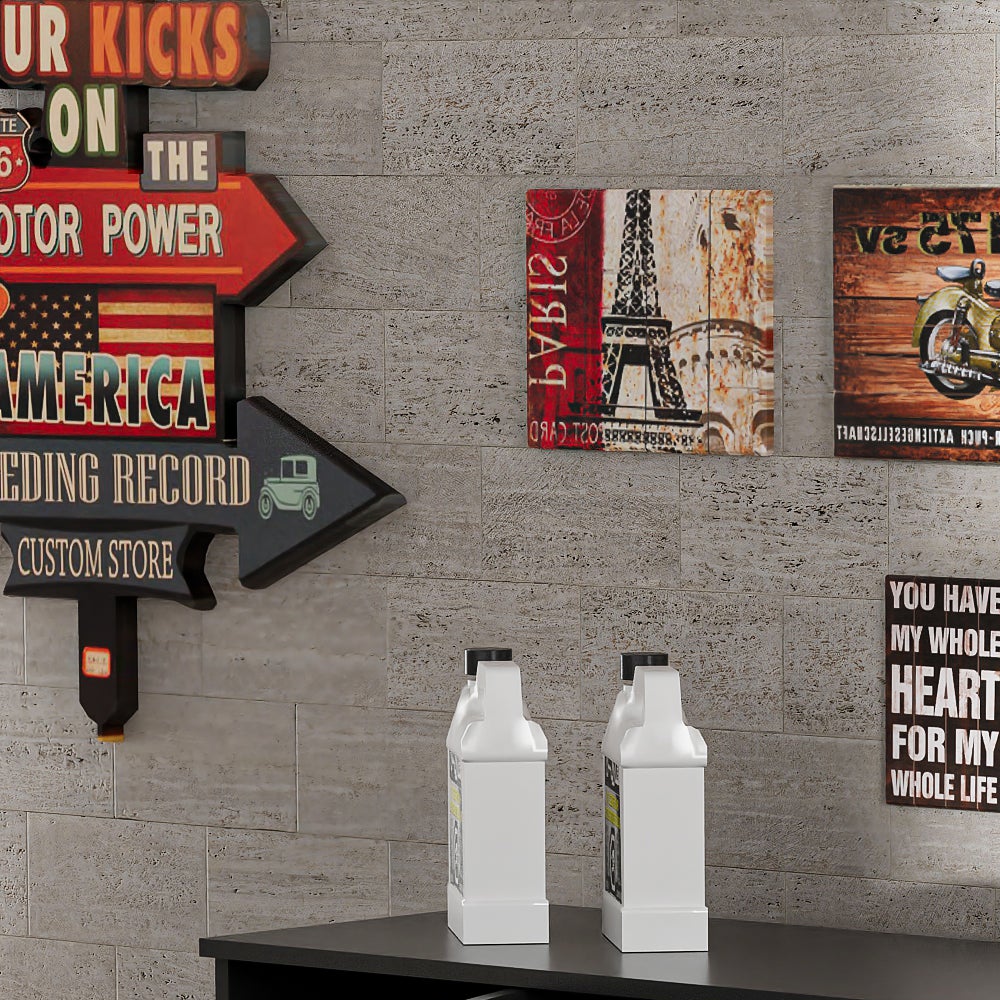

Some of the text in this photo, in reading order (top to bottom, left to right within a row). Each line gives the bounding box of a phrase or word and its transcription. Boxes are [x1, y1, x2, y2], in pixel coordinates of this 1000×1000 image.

[91, 3, 239, 77] KICKS
[49, 86, 117, 155] ON
[147, 140, 209, 182] THE
[102, 203, 224, 257] POWER
[112, 453, 251, 507] RECORD
[18, 536, 173, 579] CUSTOM STORE
[889, 580, 936, 611] YOU
[891, 624, 923, 653] MY
[891, 664, 1000, 721] HEART
[892, 723, 999, 767] FOR MY
[890, 769, 998, 805] WHOLE LIFE
